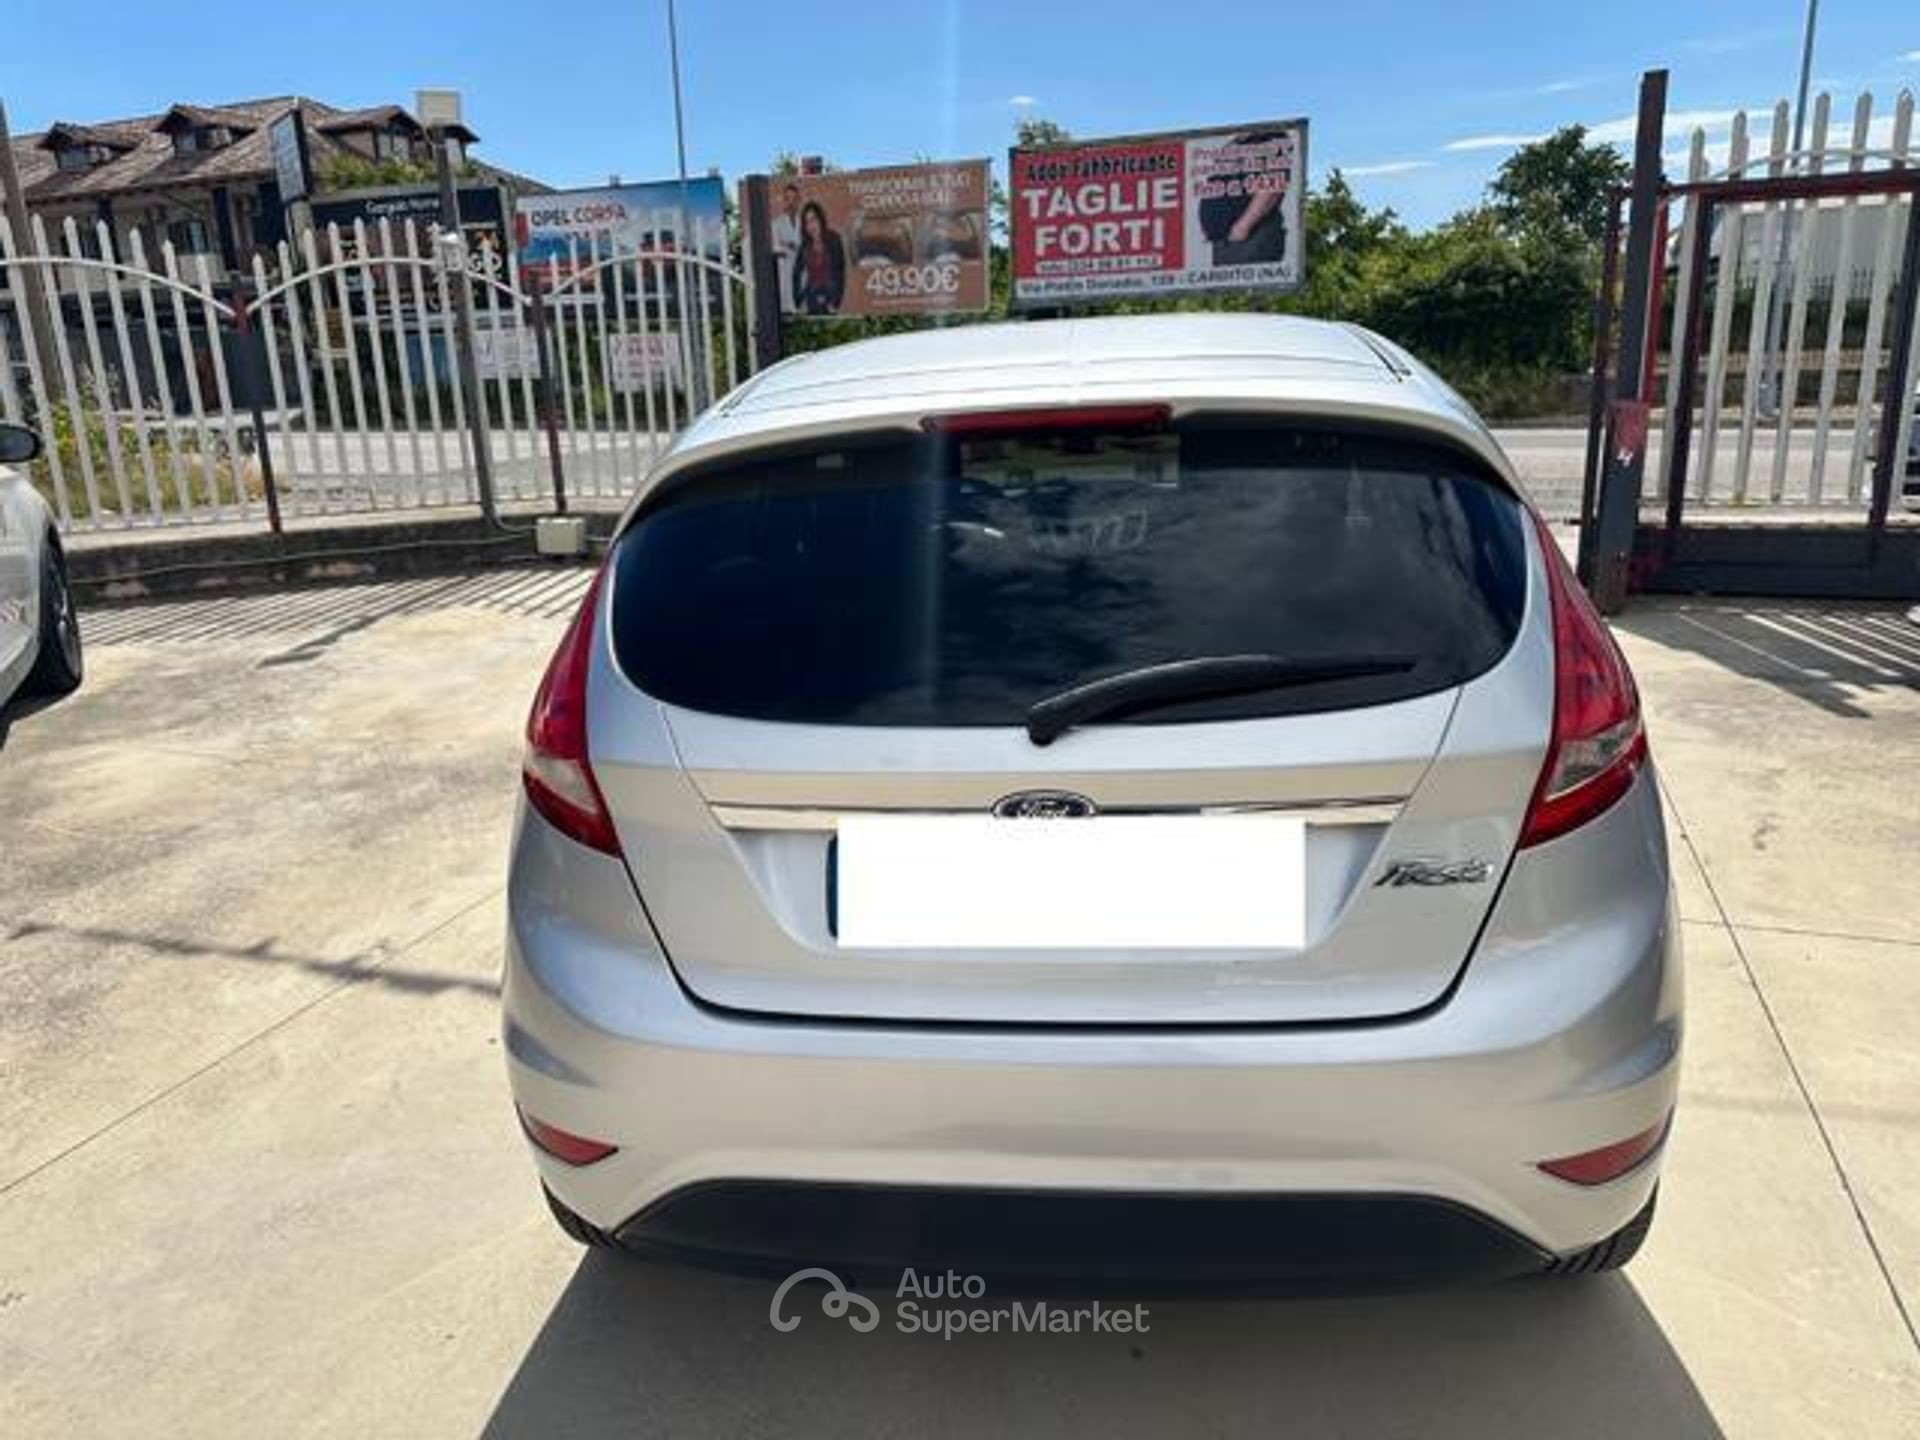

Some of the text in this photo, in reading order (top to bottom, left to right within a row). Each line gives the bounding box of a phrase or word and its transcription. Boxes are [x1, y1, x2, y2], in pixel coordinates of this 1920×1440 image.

[531, 204, 629, 227] OPEL CORSA
[1021, 177, 1178, 219] TAGLIE
[1034, 216, 1165, 257] FORTI
